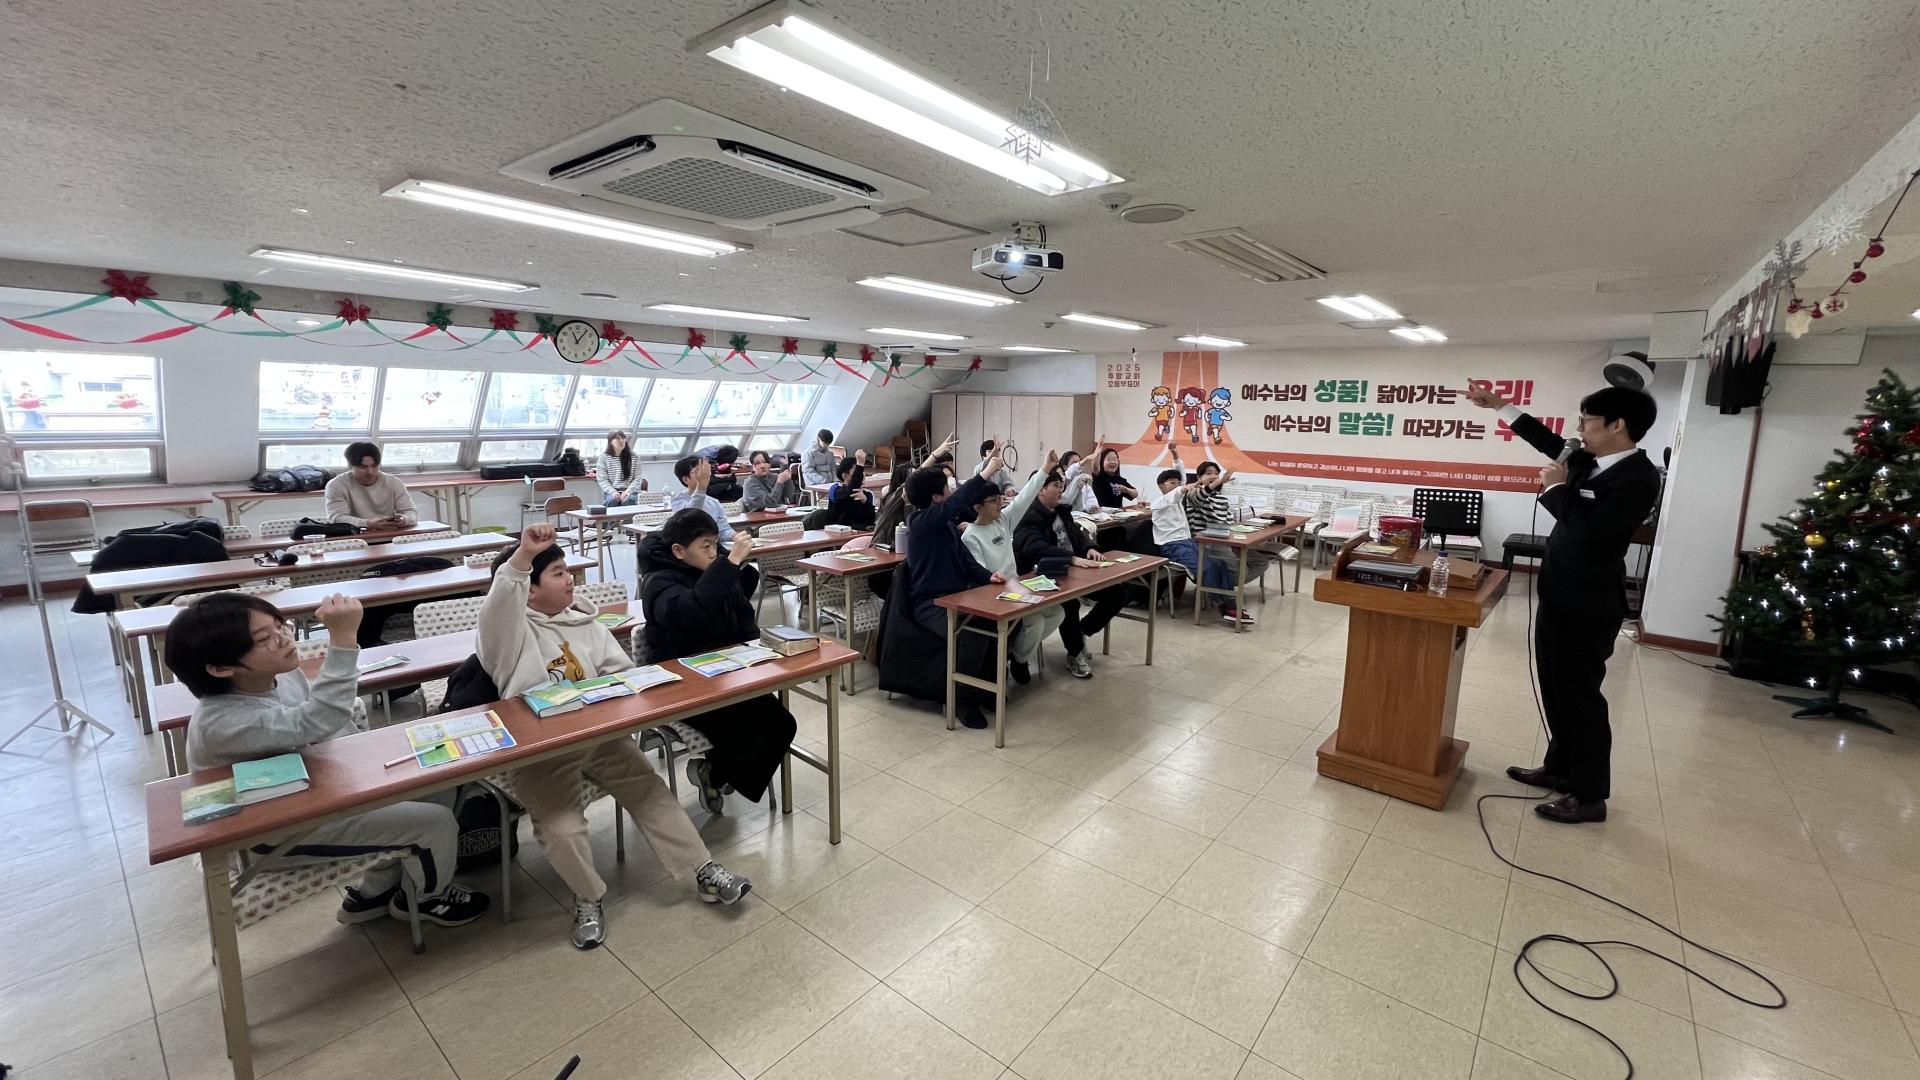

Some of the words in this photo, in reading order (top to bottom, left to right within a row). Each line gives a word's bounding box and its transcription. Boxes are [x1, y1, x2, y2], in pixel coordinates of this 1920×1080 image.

[1241, 384, 1307, 402] 예수님의
[1314, 379, 1368, 403] 성품!
[1377, 384, 1457, 404] 닮아가는
[1263, 414, 1331, 434] 예수님의
[1338, 411, 1394, 437] 말씀!
[1403, 418, 1486, 440] 따라가는
